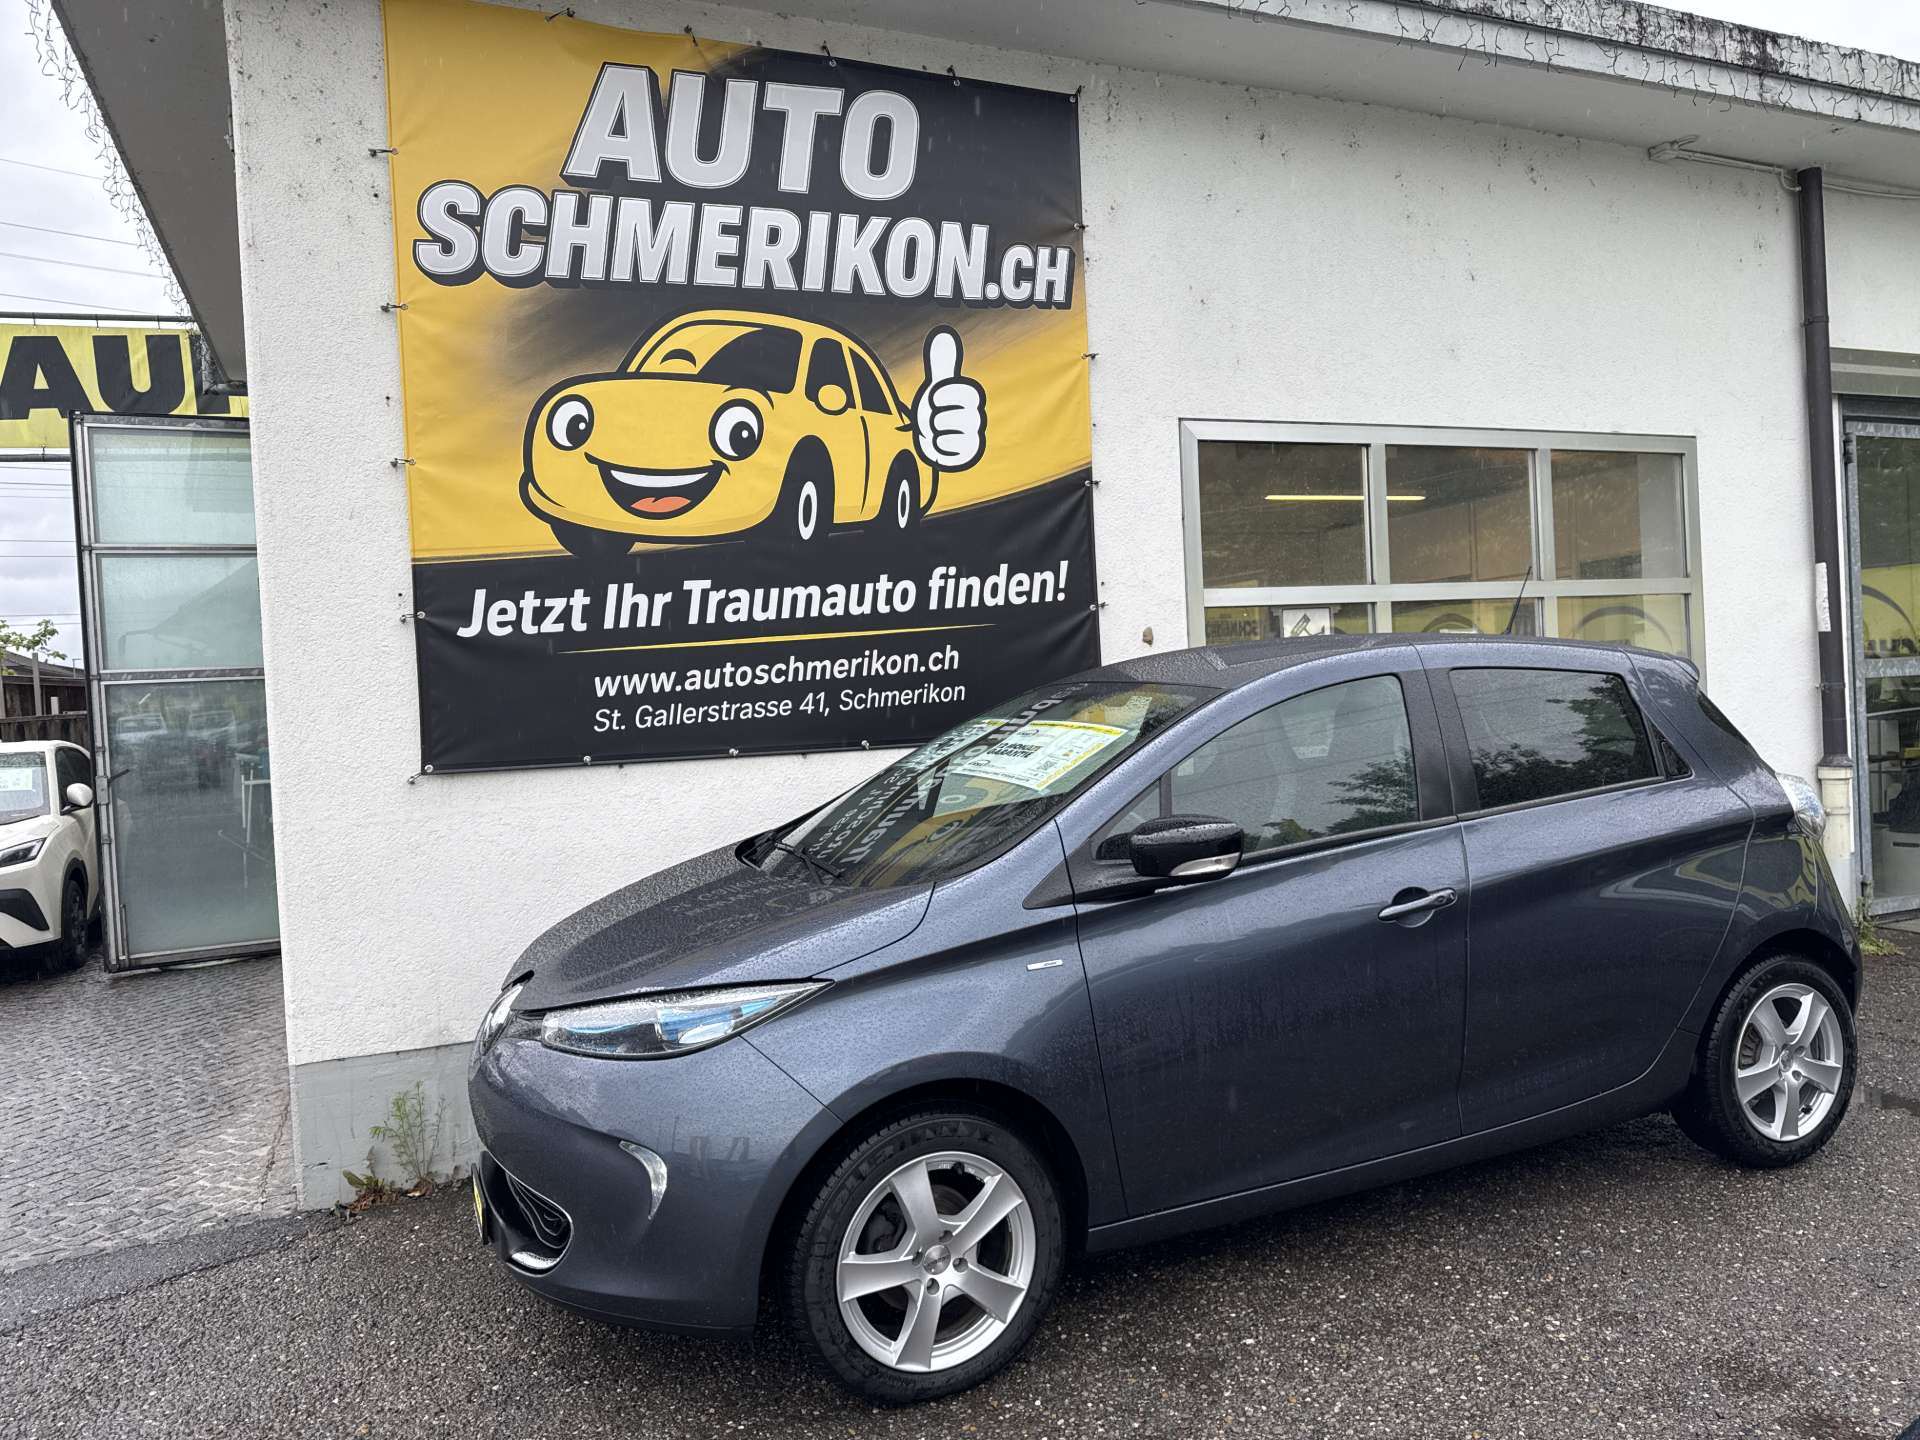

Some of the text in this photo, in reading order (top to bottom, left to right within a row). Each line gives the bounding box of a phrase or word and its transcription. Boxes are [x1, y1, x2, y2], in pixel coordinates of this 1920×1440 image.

[562, 63, 920, 201] AUTO
[415, 182, 1071, 303] SCHMERIKON.CH
[0, 334, 230, 420] AU
[456, 559, 1069, 638] Jetzt Ihr Traumauto finden!
[593, 683, 966, 732] St. Gallerstrasse 41, Schmerikon
[594, 644, 959, 698] www.autoschmerikon.ch
